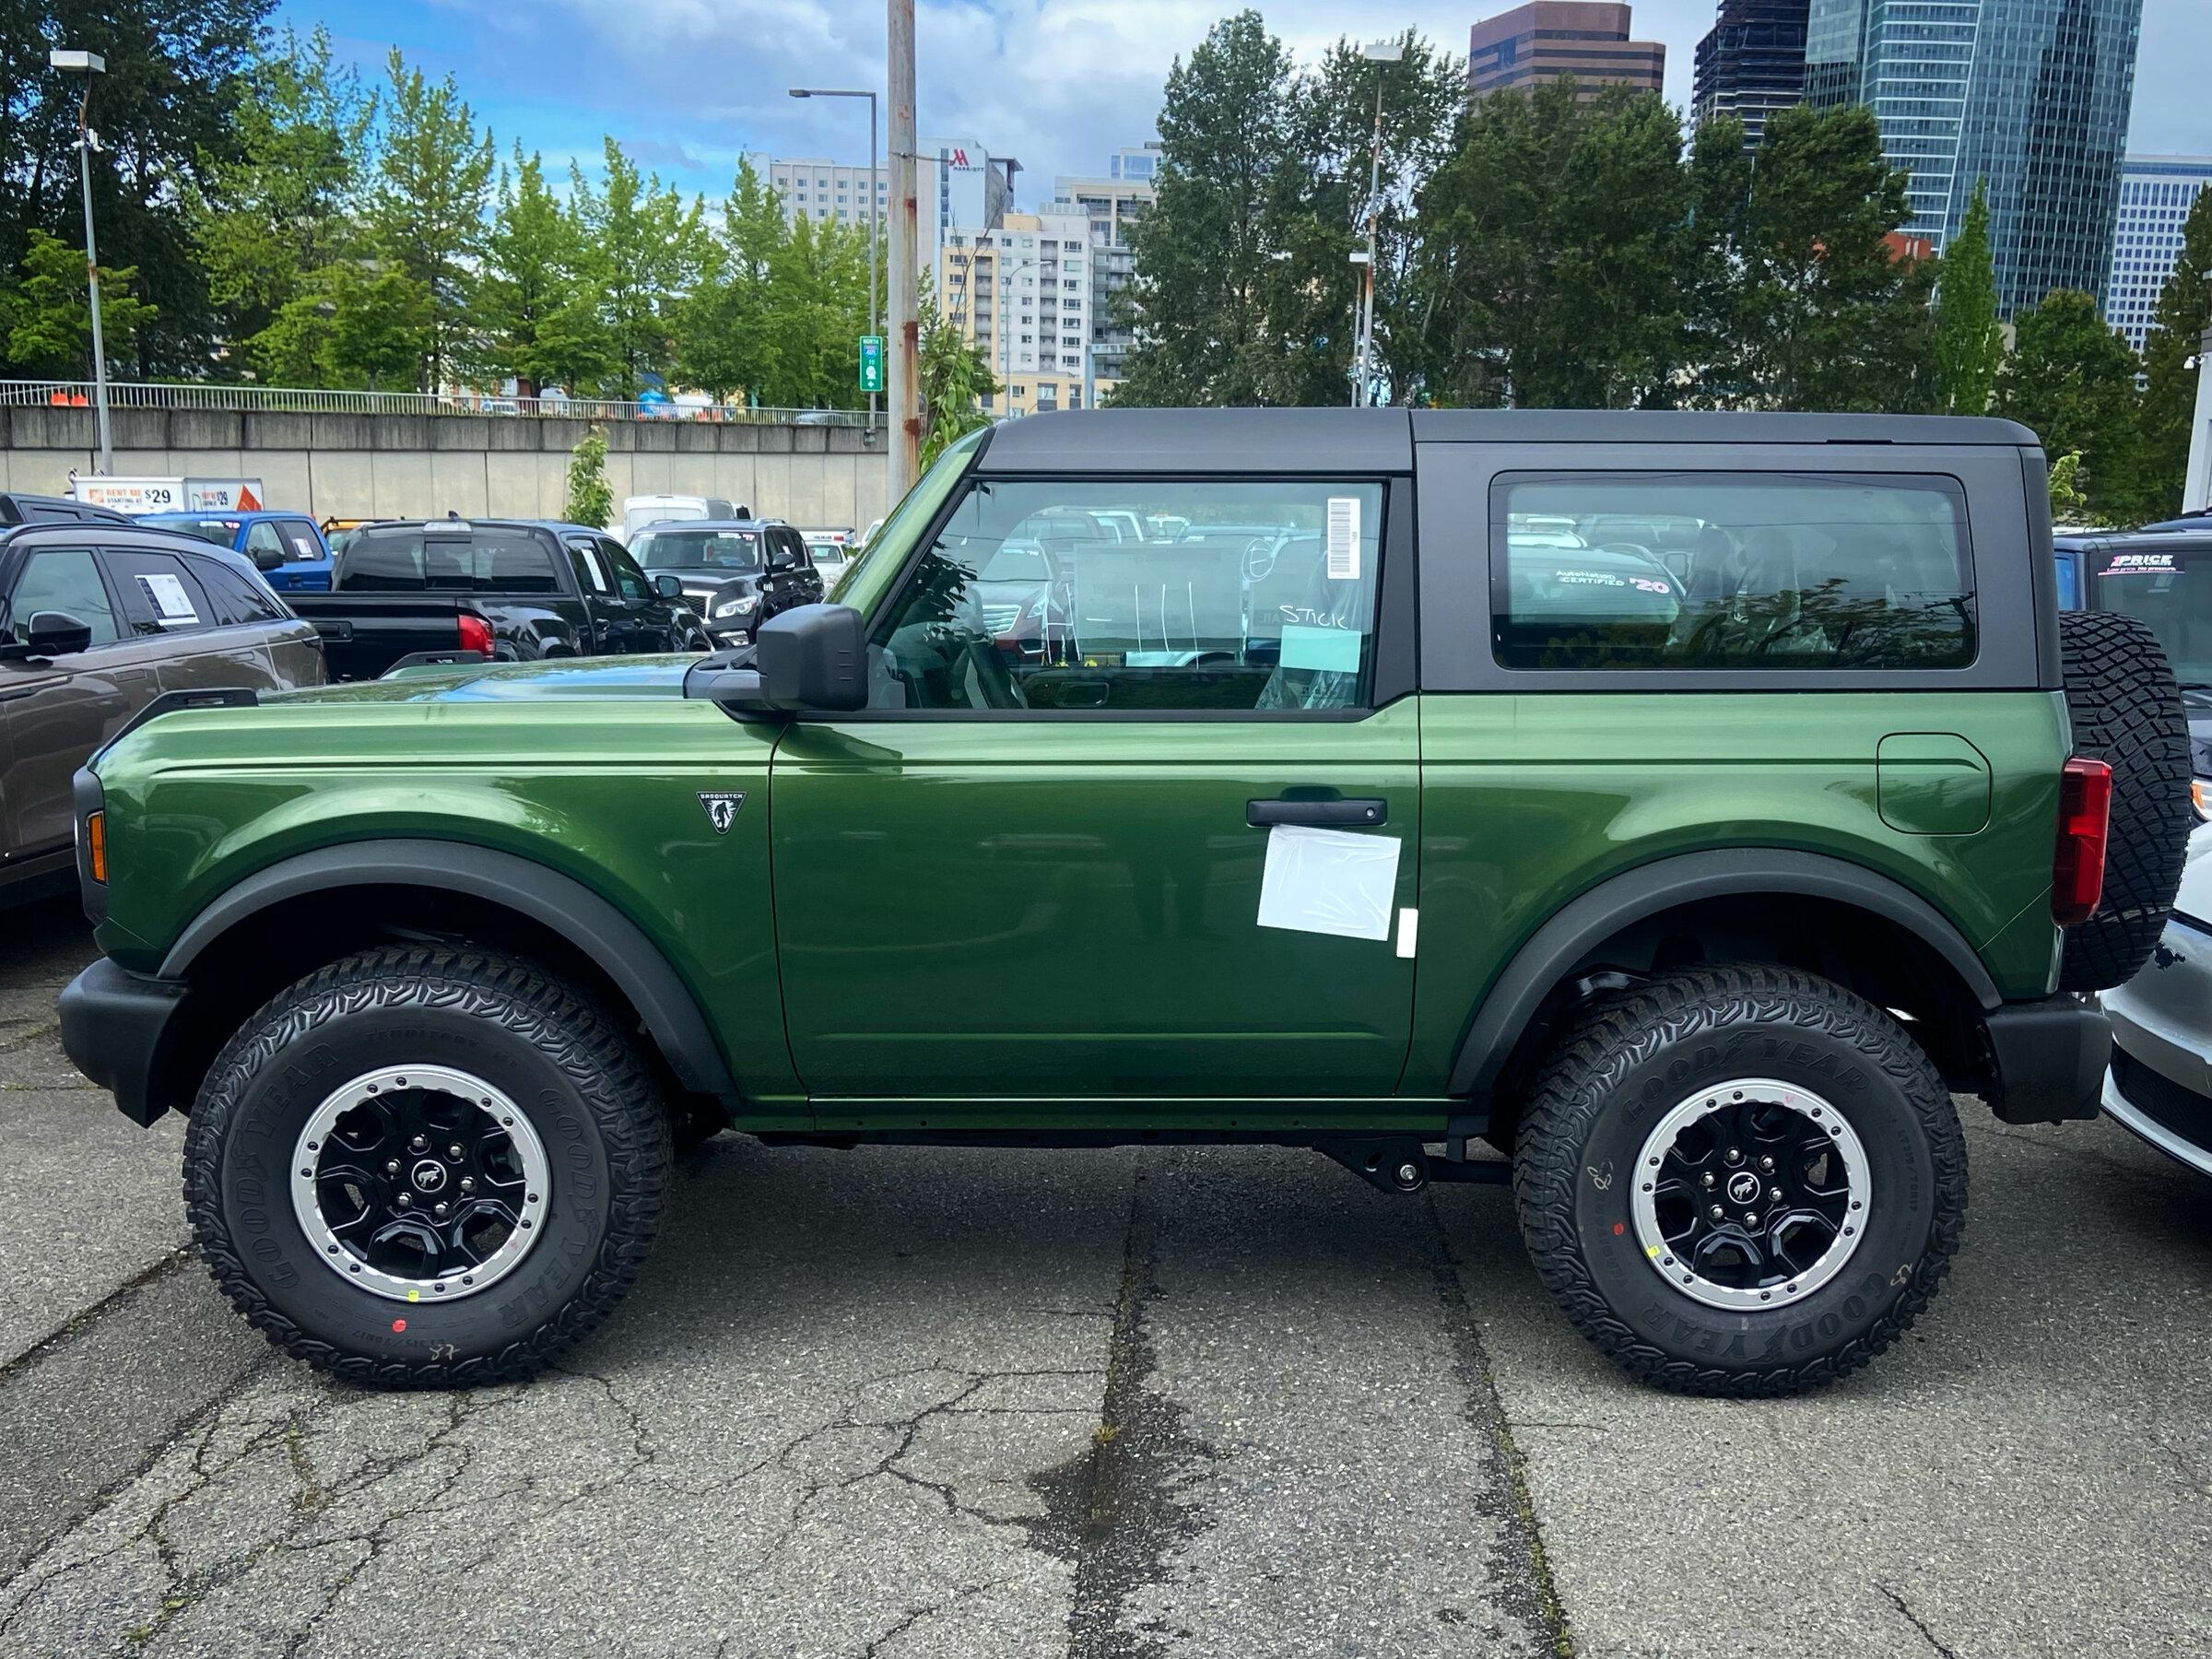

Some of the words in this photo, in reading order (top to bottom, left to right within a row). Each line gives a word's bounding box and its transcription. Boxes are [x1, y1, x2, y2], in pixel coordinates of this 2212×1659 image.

[144, 488, 171, 503] $29
[1556, 571, 1617, 582] AutoNation
[1560, 577, 1625, 586] CERTIFIED
[1278, 605, 1349, 629] STICK
